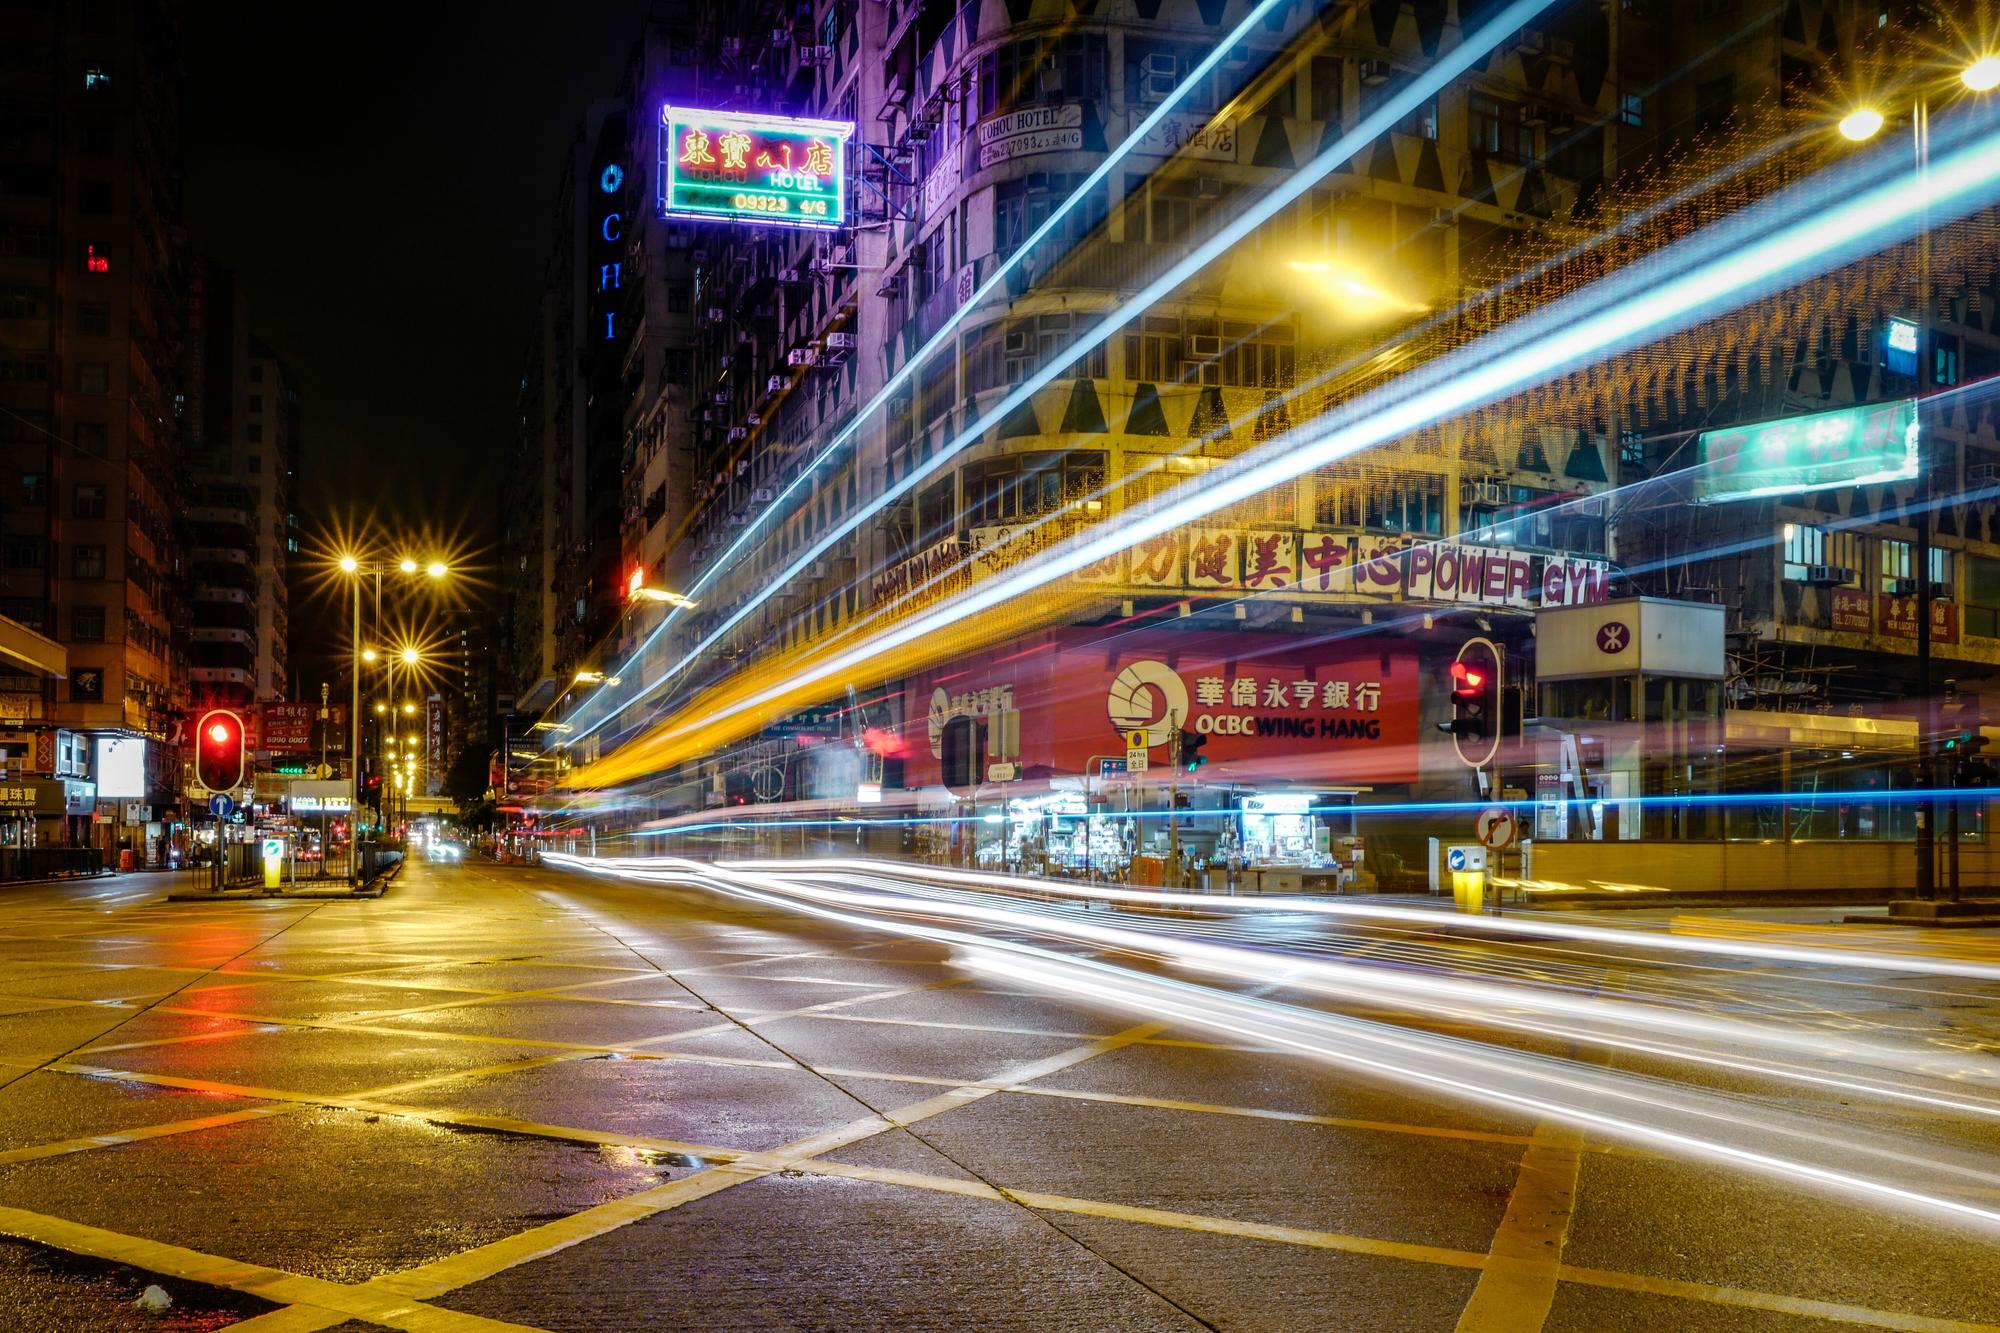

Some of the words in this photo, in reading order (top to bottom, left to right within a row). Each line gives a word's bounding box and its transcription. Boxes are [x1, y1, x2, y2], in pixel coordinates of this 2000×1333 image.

[982, 116, 1013, 142] TOHOU
[1017, 108, 1058, 130] HOTEL
[770, 171, 824, 192] HOTEL
[1409, 549, 1531, 600] POWER
[1544, 563, 1609, 603] GYM
[1196, 677, 1381, 711] 華僑永亨銀行
[1195, 714, 1254, 735] OCBC
[1255, 717, 1315, 738] WING
[1320, 719, 1380, 740] HANG
